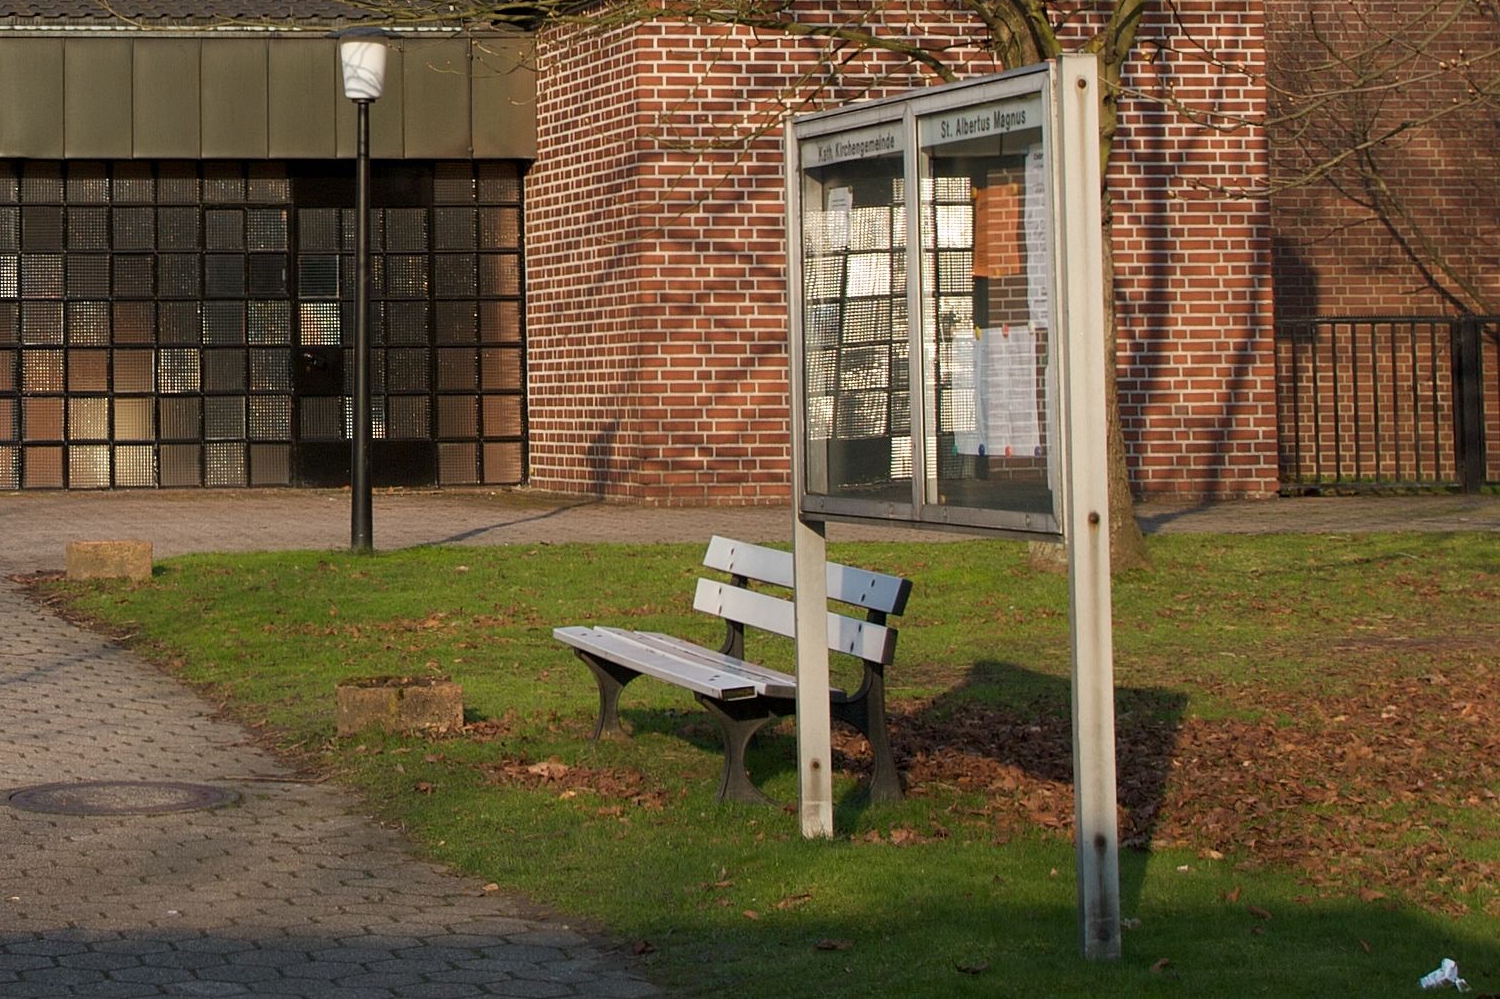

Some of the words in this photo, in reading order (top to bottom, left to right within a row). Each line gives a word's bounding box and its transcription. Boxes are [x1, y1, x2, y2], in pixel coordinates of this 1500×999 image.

[940, 119, 953, 139] St.
[955, 114, 991, 137] Albertus
[993, 109, 1026, 131] Magnus
[835, 130, 895, 158] Kirchengemeinde
